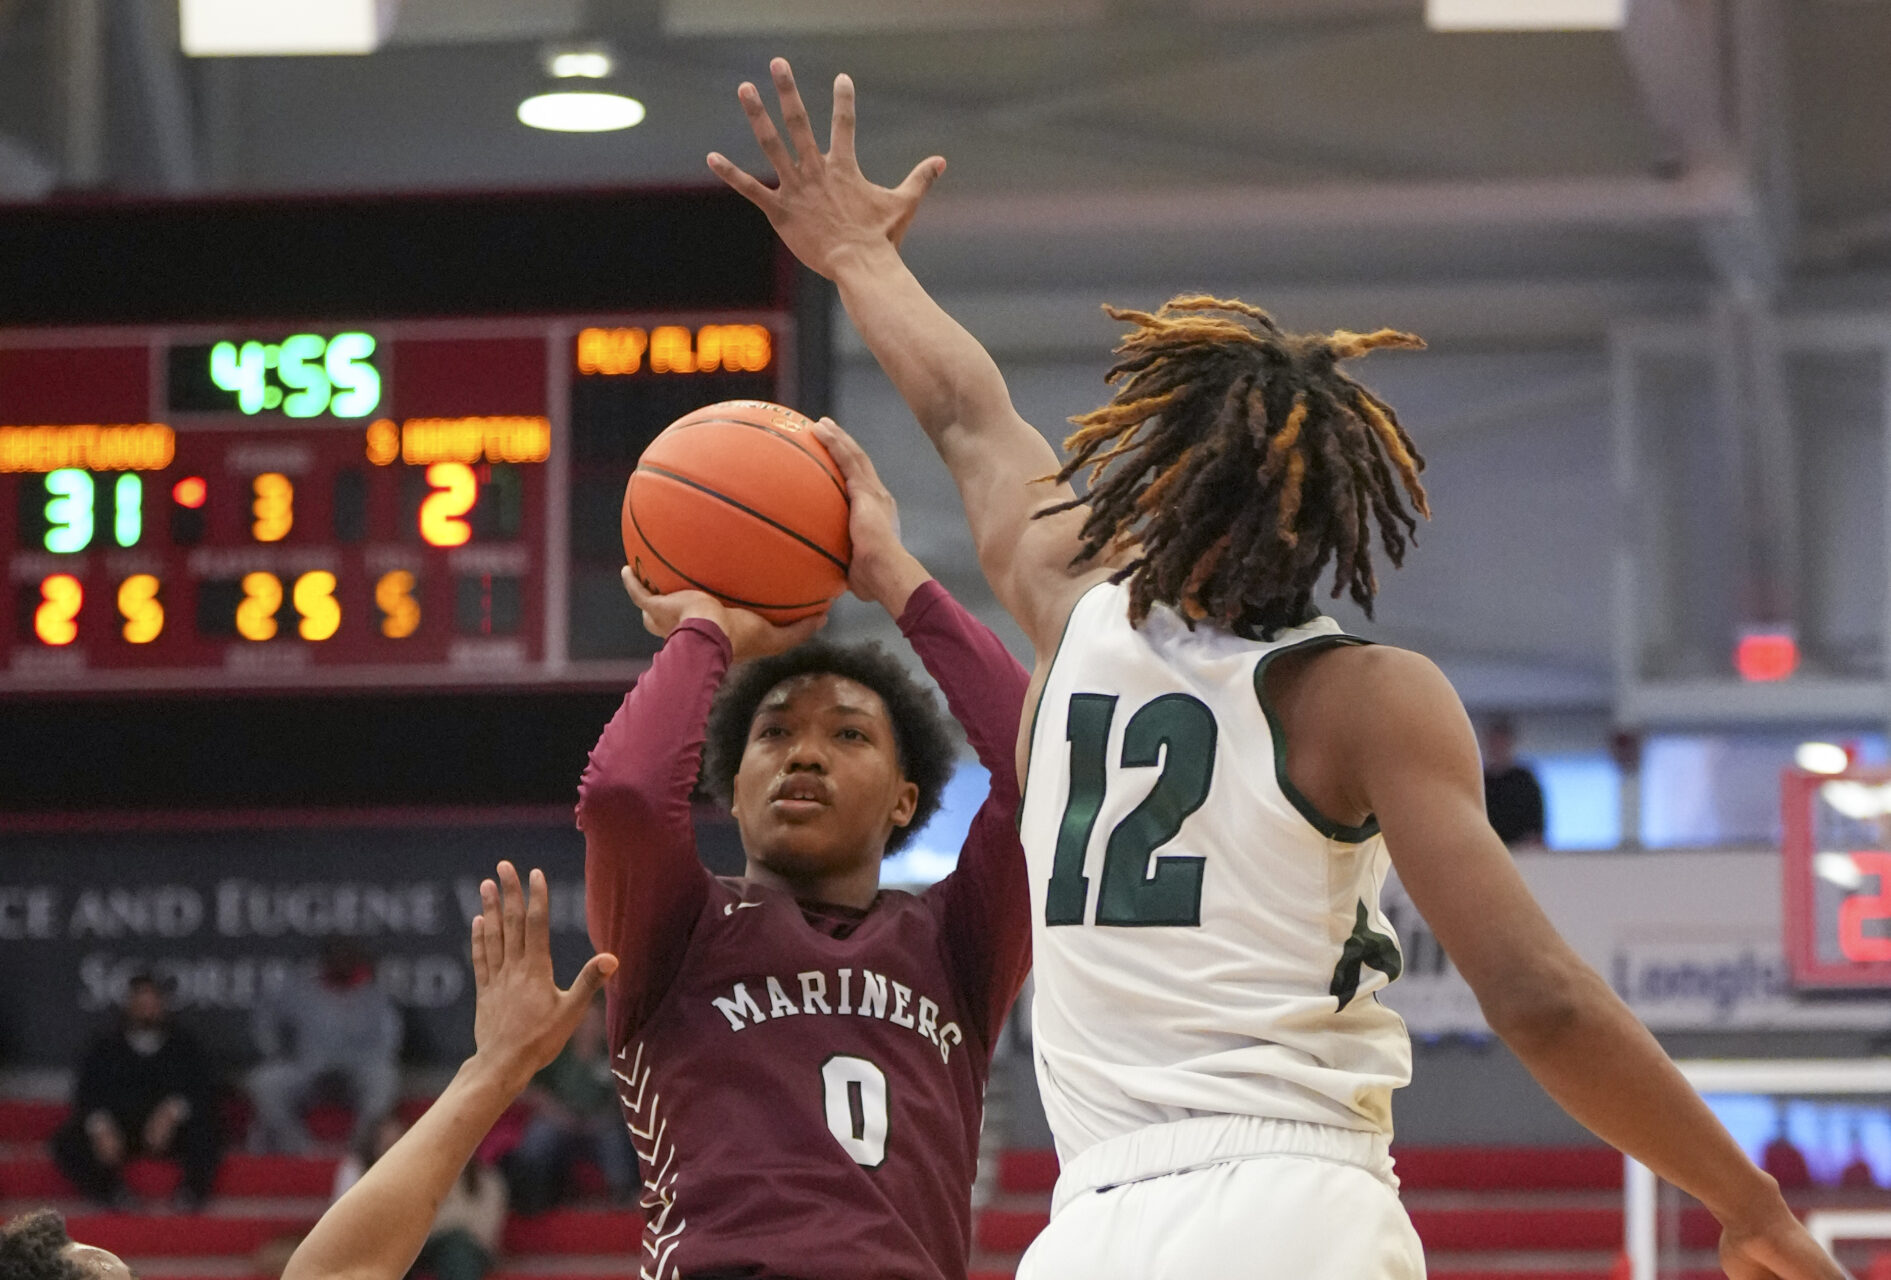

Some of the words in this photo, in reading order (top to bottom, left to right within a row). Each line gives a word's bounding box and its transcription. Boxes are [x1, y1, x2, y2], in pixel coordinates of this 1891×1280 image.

[210, 332, 381, 418] 4:55
[420, 462, 477, 547] 2
[1045, 692, 1218, 927] 12
[711, 968, 963, 1065] MARINERS
[820, 1053, 890, 1170] 0
